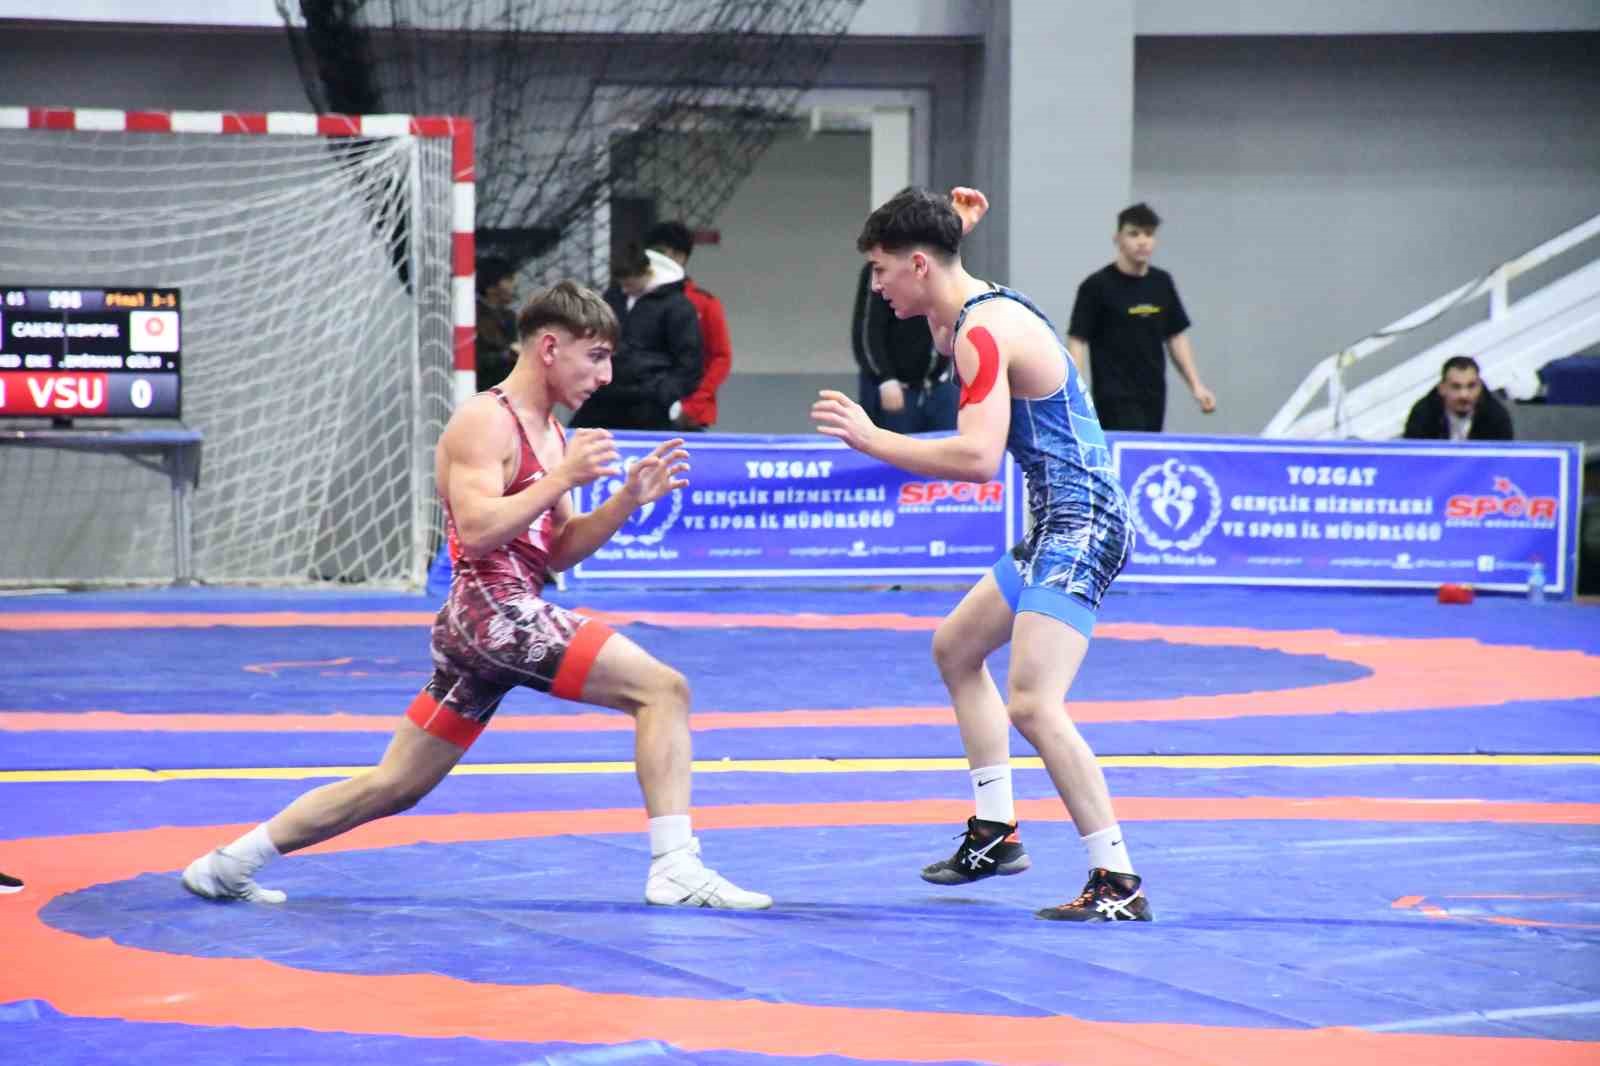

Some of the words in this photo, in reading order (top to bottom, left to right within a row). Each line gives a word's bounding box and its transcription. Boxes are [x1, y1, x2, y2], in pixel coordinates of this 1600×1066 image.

[27, 376, 104, 409] VSU
[130, 378, 153, 409] 0
[745, 460, 833, 479] YOZGAT
[1286, 465, 1377, 486] YOZGAT
[691, 486, 769, 508] GENÇLİK
[773, 485, 886, 505] HİZMETLERİ
[898, 480, 1005, 506] SPOR
[1229, 493, 1311, 515] GENÇLİK
[1314, 495, 1434, 515] HİZMETLERİ
[1445, 494, 1558, 520] SPOR
[683, 515, 705, 529] VE
[709, 515, 756, 529] SPOR
[759, 512, 779, 529] İL
[783, 509, 895, 529] MÜDÜRLÜĞÜ
[1221, 520, 1245, 538] VE
[1248, 521, 1298, 539] SPOR
[1301, 519, 1321, 539] İL
[1324, 521, 1442, 541] MÜDÜRLÜĞÜ
